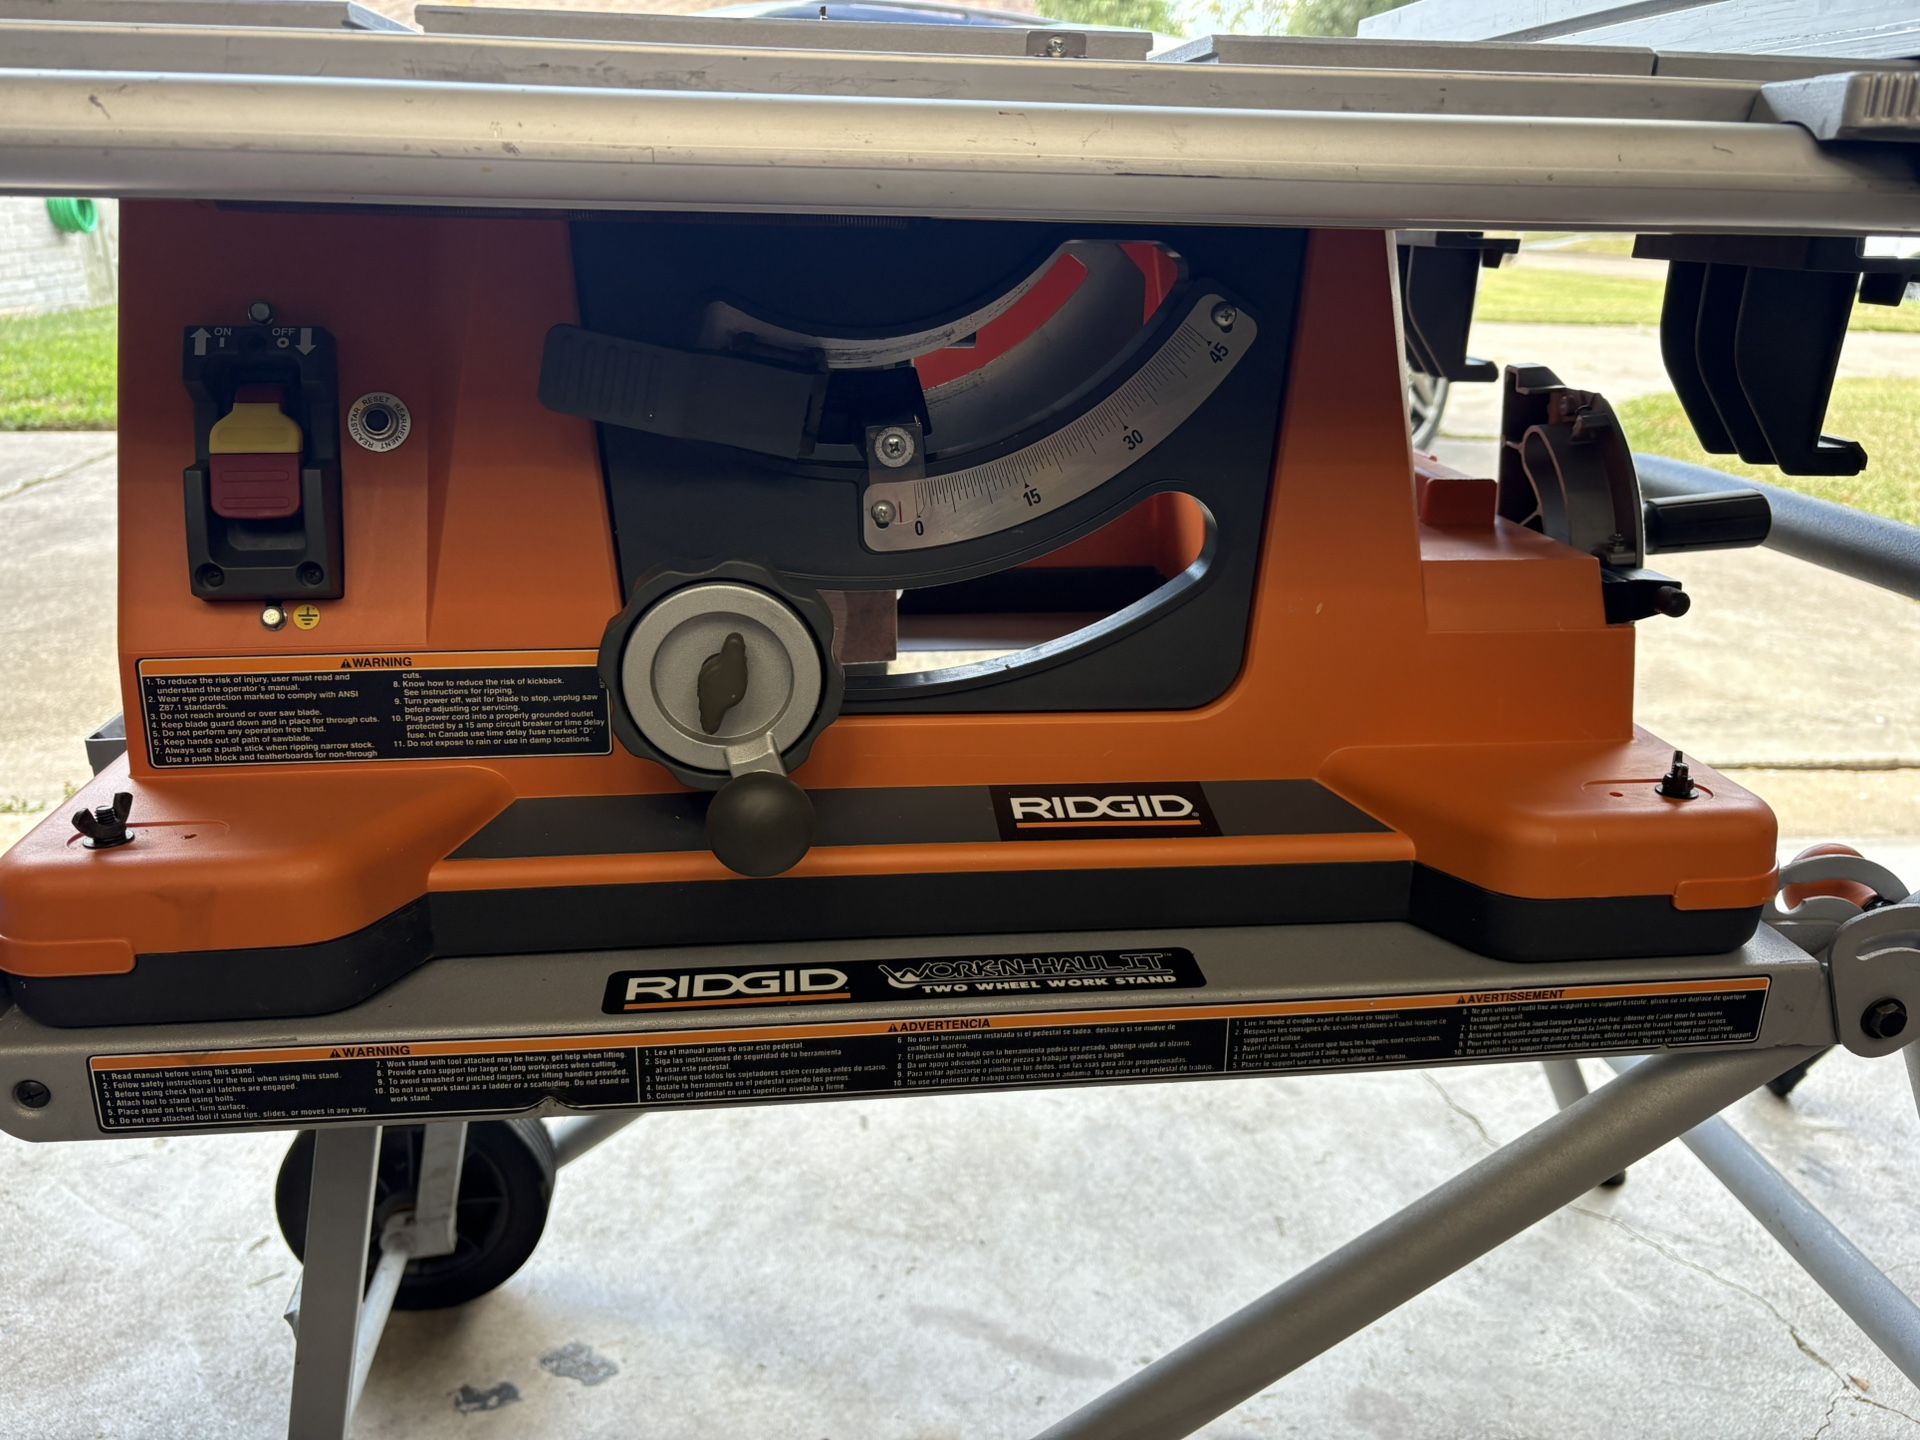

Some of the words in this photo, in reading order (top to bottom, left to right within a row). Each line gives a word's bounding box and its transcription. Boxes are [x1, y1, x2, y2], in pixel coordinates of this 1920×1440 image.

[214, 327, 232, 336] ON
[272, 327, 296, 336] OFF
[1209, 342, 1228, 364] 45
[362, 396, 390, 405] RESET
[350, 408, 374, 448] REAJUSTAR
[380, 402, 408, 450] REARMEMENT
[1122, 429, 1144, 450] 30
[1022, 488, 1042, 506] 15
[914, 520, 924, 536] 0
[352, 656, 412, 668] WARNING
[243, 675, 268, 684] injury,
[199, 693, 241, 703] protection
[287, 691, 317, 701] comply
[483, 686, 514, 696] ripping.
[530, 694, 550, 703] stop,
[552, 694, 580, 703] unplug
[431, 704, 469, 714] adjusting
[481, 703, 520, 713] servicing.
[161, 720, 182, 729] Keep
[210, 719, 234, 728] guard
[288, 717, 310, 726] place
[325, 716, 358, 726] through
[404, 714, 423, 723] Plug
[495, 711, 529, 721] properly
[530, 710, 569, 720] grounded
[192, 728, 225, 737] perform
[244, 726, 283, 736] operation
[1010, 794, 1194, 820] RIDGID
[625, 968, 848, 1000] RIDGID
[922, 984, 968, 993] TWO
[975, 981, 1041, 990] WHEEL
[1047, 977, 1108, 988] WORK
[1115, 975, 1177, 984] STAND
[1467, 990, 1566, 1004] AVERTISSEMENT
[900, 1018, 990, 1032] ADVERTENCIA
[342, 1046, 410, 1058] WARNING
